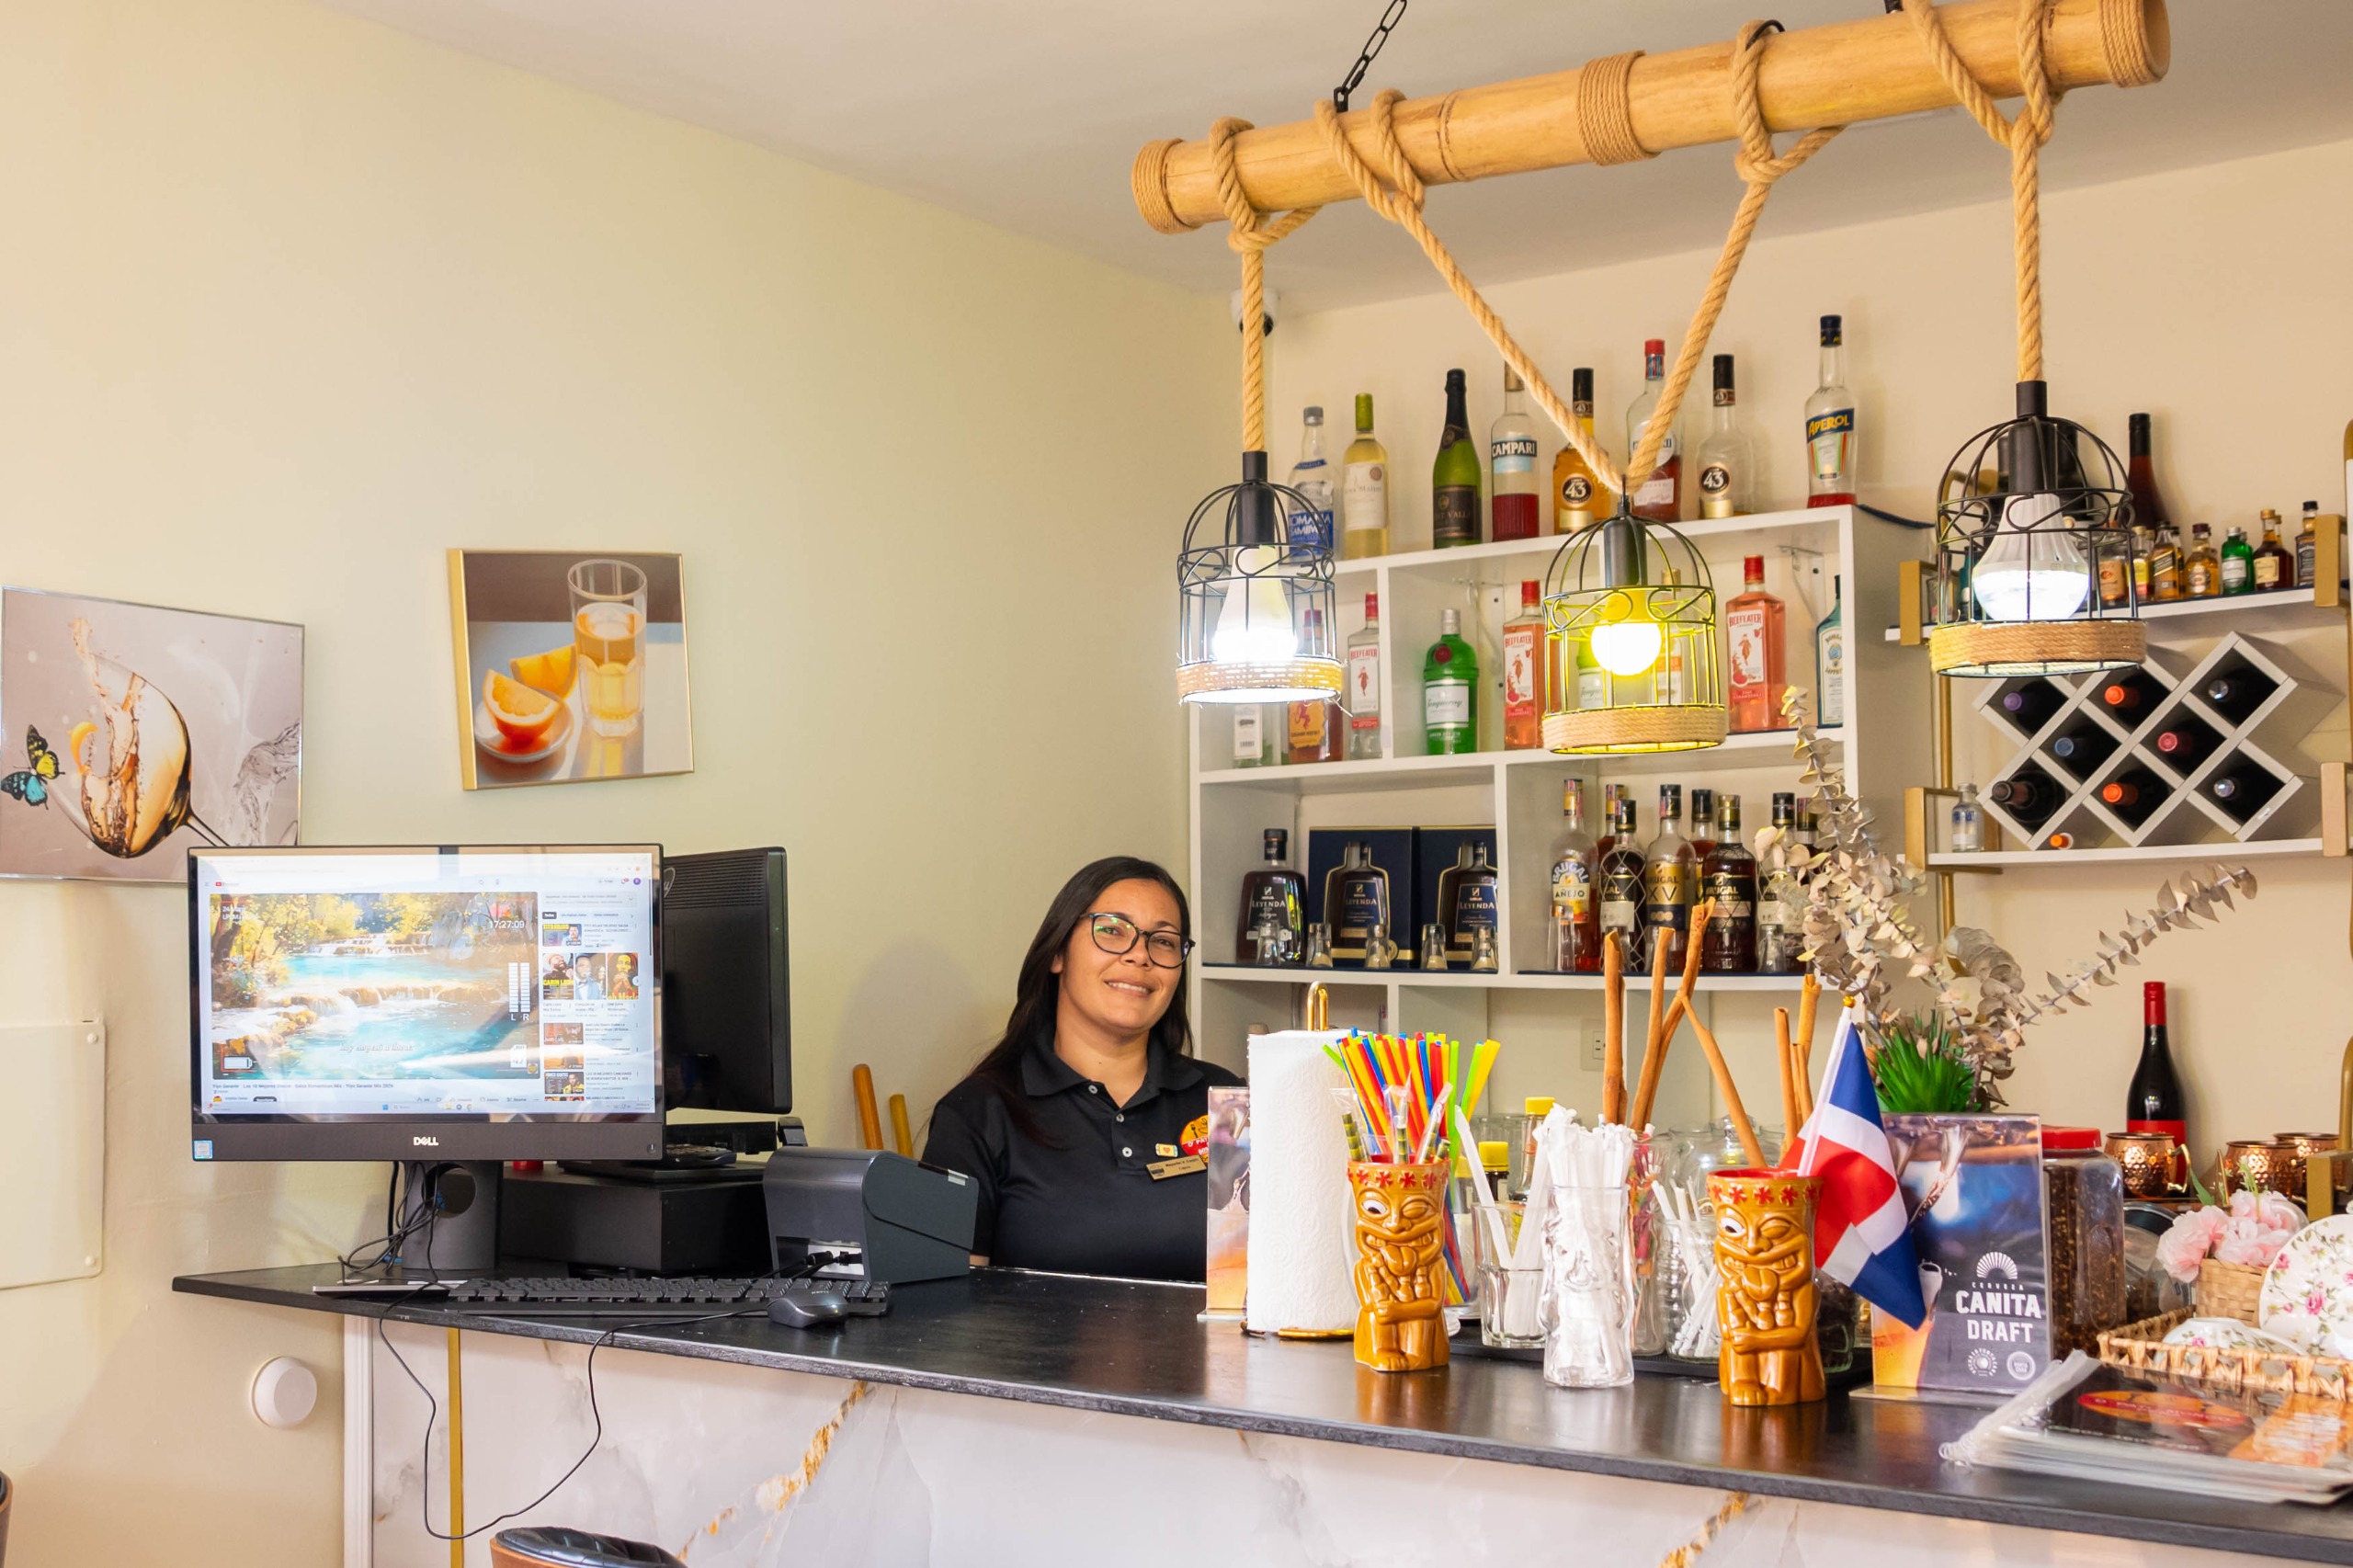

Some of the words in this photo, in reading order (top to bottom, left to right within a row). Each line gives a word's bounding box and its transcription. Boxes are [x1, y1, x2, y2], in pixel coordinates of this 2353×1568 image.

[1808, 415, 1849, 437] APEROL
[1492, 442, 1535, 457] CAMPARI
[1703, 471, 1724, 488] 43
[1564, 482, 1586, 498] 43
[1729, 613, 1762, 627] BEEFEATER
[1505, 635, 1533, 647] BEEFEATER
[1350, 648, 1378, 660] BEEFEATER
[1552, 862, 1589, 882] BRUGAL
[1555, 889, 1586, 898] AÑEJO
[1252, 900, 1286, 908] LEYENDA
[511, 1013, 517, 1021] L
[414, 1136, 438, 1146] DELL
[1955, 1290, 2042, 1319] CANITA
[1967, 1319, 2034, 1343] DRAFT
